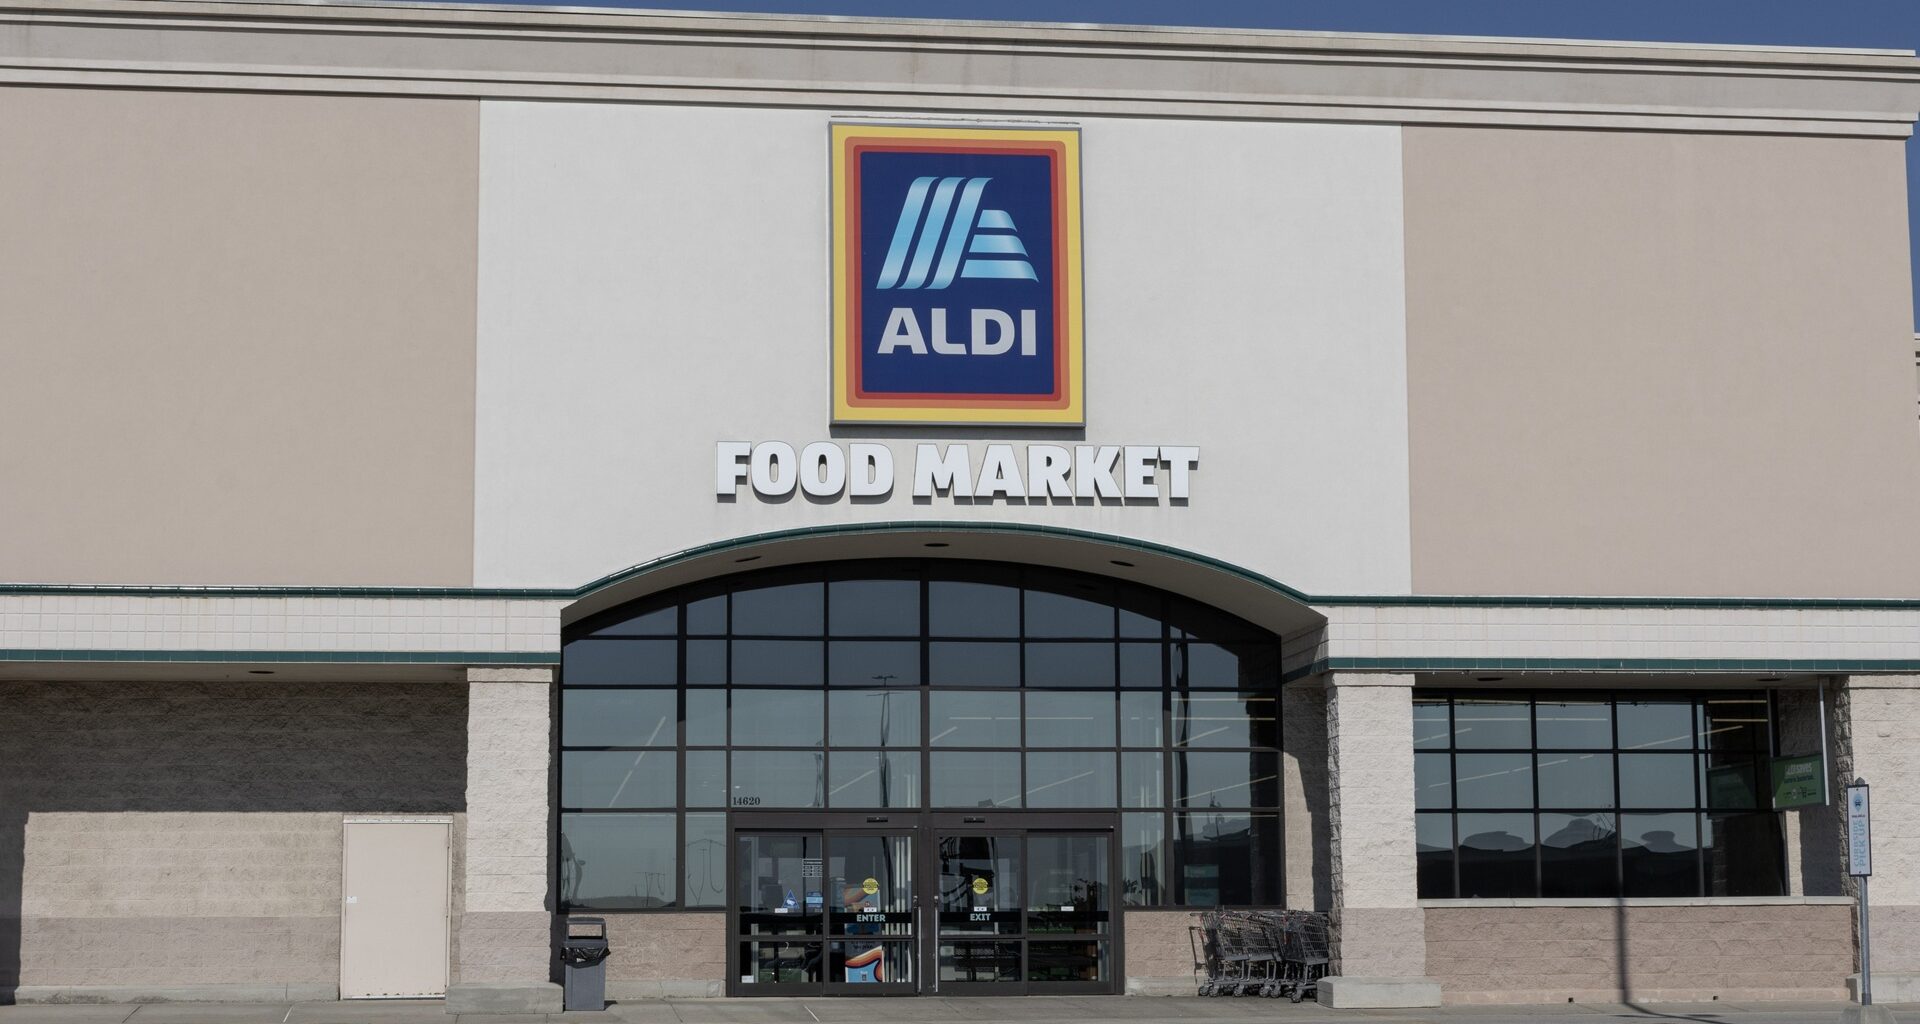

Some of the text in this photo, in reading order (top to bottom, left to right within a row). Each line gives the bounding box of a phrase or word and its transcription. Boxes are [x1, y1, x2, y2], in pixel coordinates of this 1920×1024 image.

[877, 307, 1036, 356] ALDI
[716, 441, 1200, 506] FOOD MARKET
[733, 796, 761, 806] 14620
[1858, 820, 1866, 836] UP
[1858, 840, 1866, 867] PICK
[856, 914, 886, 922] ENTER
[970, 913, 991, 921] EXIT
